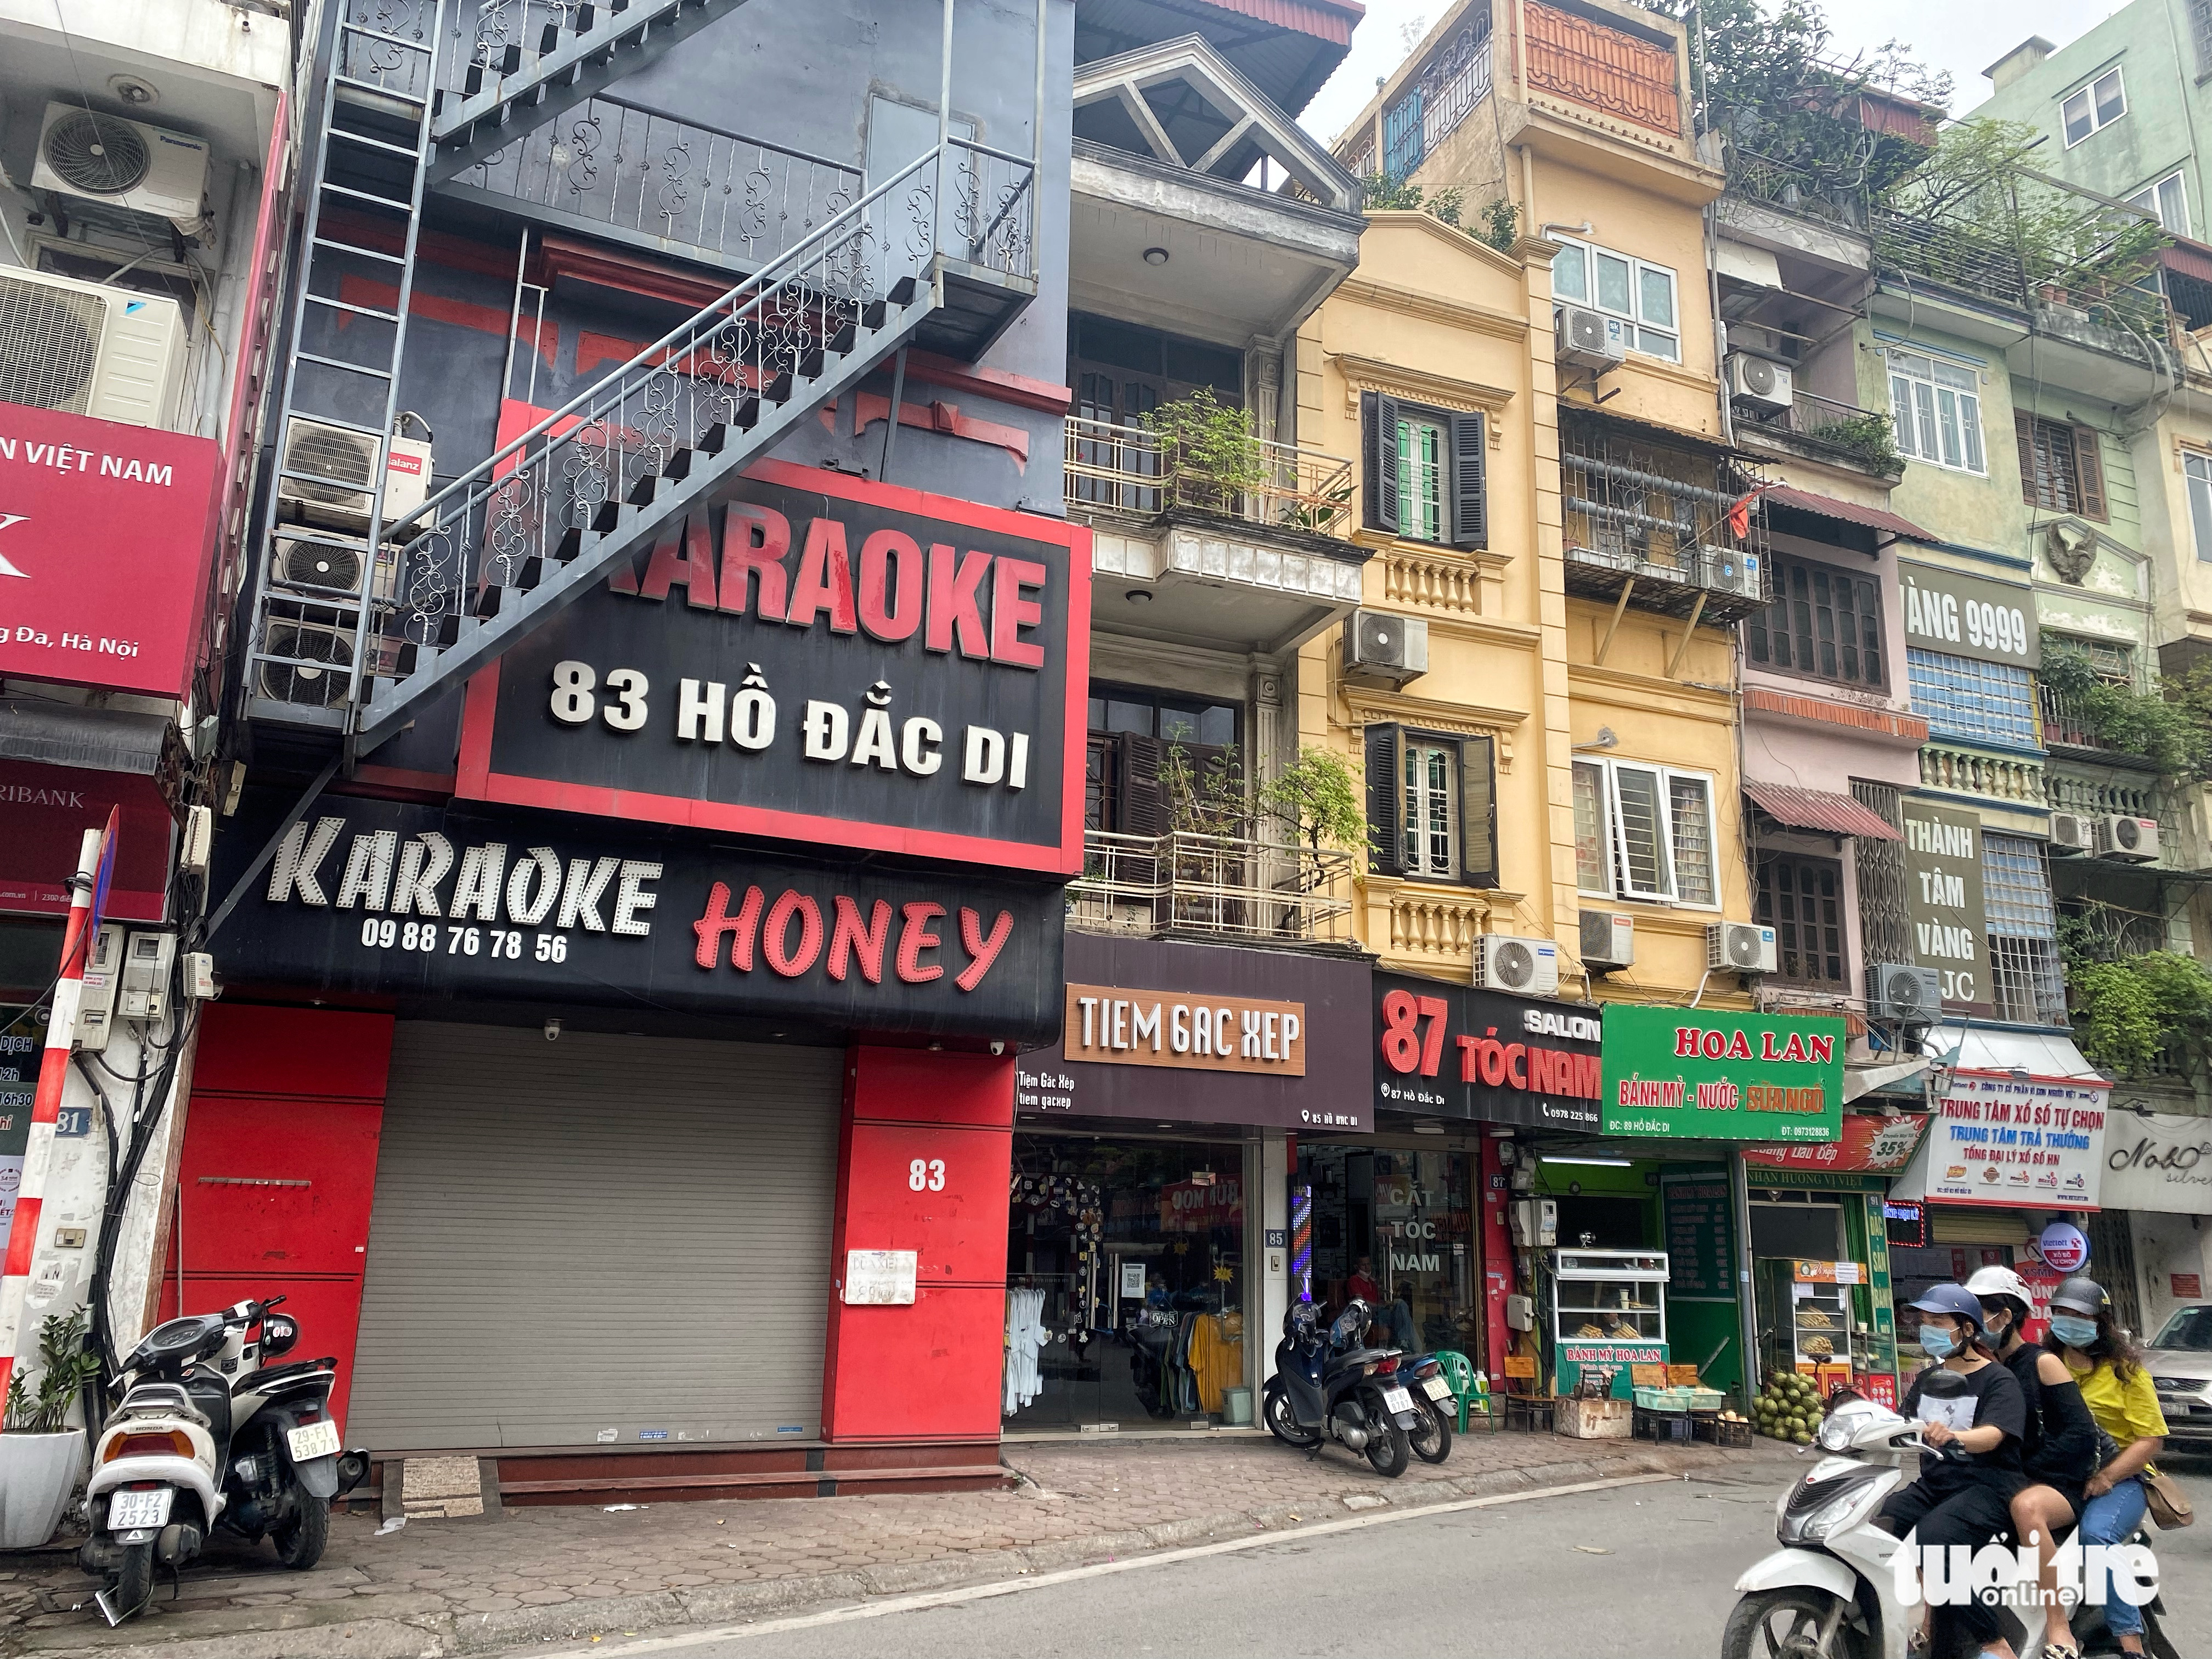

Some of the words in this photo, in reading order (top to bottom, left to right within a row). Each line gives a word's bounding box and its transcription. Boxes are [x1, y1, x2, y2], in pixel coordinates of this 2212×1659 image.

[160, 135, 202, 151] Panasonic
[25, 442, 94, 475] VIỆT
[100, 455, 173, 487] NAM
[389, 457, 419, 471] alanz
[608, 500, 1046, 670] ARAOKE
[1899, 577, 1960, 643] ÀNG
[1966, 599, 2027, 656] 9999
[15, 626, 54, 648] Đa,
[61, 632, 92, 652] Hà
[99, 637, 139, 660] Nội
[550, 659, 648, 732] 83
[678, 662, 776, 751] HỒ
[803, 680, 943, 776] ĐẮC
[963, 724, 1029, 789] DI
[1906, 815, 1973, 859] THÀNH
[267, 816, 664, 936] KARAOKE
[1920, 871, 1965, 909] TÂM
[362, 917, 396, 947] 09
[402, 922, 436, 952] 88
[447, 925, 479, 956] 76
[489, 930, 522, 960] 78
[534, 933, 567, 963] 56
[693, 881, 1014, 992] HONEY
[1917, 918, 1974, 960] VÀNG
[1942, 970, 1976, 1002] JC
[1077, 997, 1162, 1051] TIEM
[1170, 1005, 1233, 1056] GAC
[1240, 1010, 1300, 1060] XEP
[1382, 989, 1447, 1076] 87
[1524, 1009, 1601, 1042] SALON
[1, 1036, 33, 1055] DỊCH
[1675, 1027, 1753, 1060] HOA
[1761, 1031, 1835, 1064] LAN
[1457, 1027, 1527, 1090] TÓC
[1528, 1047, 1601, 1100] NAM
[1019, 1071, 1038, 1088] Tiệm
[1041, 1072, 1056, 1088] Gác
[1058, 1074, 1075, 1092] Xép
[1619, 1073, 1661, 1107] BÁNH
[1662, 1075, 1686, 1108] MỲ
[1697, 1077, 1739, 1110] NƯỚC
[1019, 1092, 1038, 1105] tiem
[1041, 1096, 1071, 1109] gacxep
[1391, 1090, 1402, 1099] 87
[1404, 1089, 1415, 1101] Hồ
[1418, 1091, 1434, 1104] Đắc
[57, 1111, 78, 1134] 81
[1312, 1114, 1321, 1124] 85
[1351, 1116, 1357, 1126] DI
[1551, 1109, 1568, 1119] 0978
[1571, 1111, 1583, 1120] 225
[1585, 1113, 1598, 1122] 866
[1610, 1120, 1622, 1130] ĐC:
[1624, 1121, 1632, 1131] 89
[1634, 1118, 1645, 1131] HỒ
[1646, 1119, 1661, 1132] ĐẮC
[1662, 1124, 1670, 1132] DI
[1940, 1098, 1980, 1120] TRUNG
[1985, 1100, 2011, 1122] TÂM
[2015, 1099, 2033, 1124] XỔ
[2035, 1102, 2052, 1125] SỐ
[2055, 1108, 2071, 1130] TỰ
[2073, 1110, 2105, 1132] CHỌN
[1781, 1126, 1792, 1136] ĐT:
[1794, 1126, 1830, 1137] 0973128836
[1950, 1126, 1989, 1143] TRUNG
[1992, 1127, 2017, 1144] TÂM
[2021, 1127, 2042, 1146] TRẢ
[2046, 1130, 2090, 1149] THƯỞNG
[1877, 1141, 1908, 1156] 35%
[1963, 1144, 1987, 1160] TỔNG
[1989, 1150, 2004, 1164] ĐẠI
[2006, 1149, 2016, 1163] LÝ
[2019, 1148, 2032, 1163] XỔ
[2033, 1150, 2046, 1164] SỐ
[2047, 1154, 2060, 1165] HN
[909, 1159, 945, 1192] 83
[1493, 1177, 1505, 1188] 87
[1839, 1174, 1864, 1187] VIỆT
[1871, 1197, 1878, 1206] 91
[1391, 1215, 1436, 1239] TÓC
[1870, 1212, 1883, 1242] ĐẶC
[1269, 1233, 1283, 1245] 85
[1391, 1254, 1440, 1272] NAM
[1873, 1245, 1887, 1272] SẢN
[2023, 1268, 2054, 1278] XSMB
[1152, 1314, 1175, 1326] OPEN
[1566, 1345, 1597, 1361] BÁNH
[1598, 1346, 1614, 1362] MỲ
[1616, 1348, 1639, 1362] HOA
[1639, 1348, 1661, 1362] LAN
[295, 1427, 328, 1444] 29-F1
[295, 1438, 335, 1458] 538.71
[121, 1493, 162, 1509] 30-F2
[117, 1510, 159, 1526] 2523
